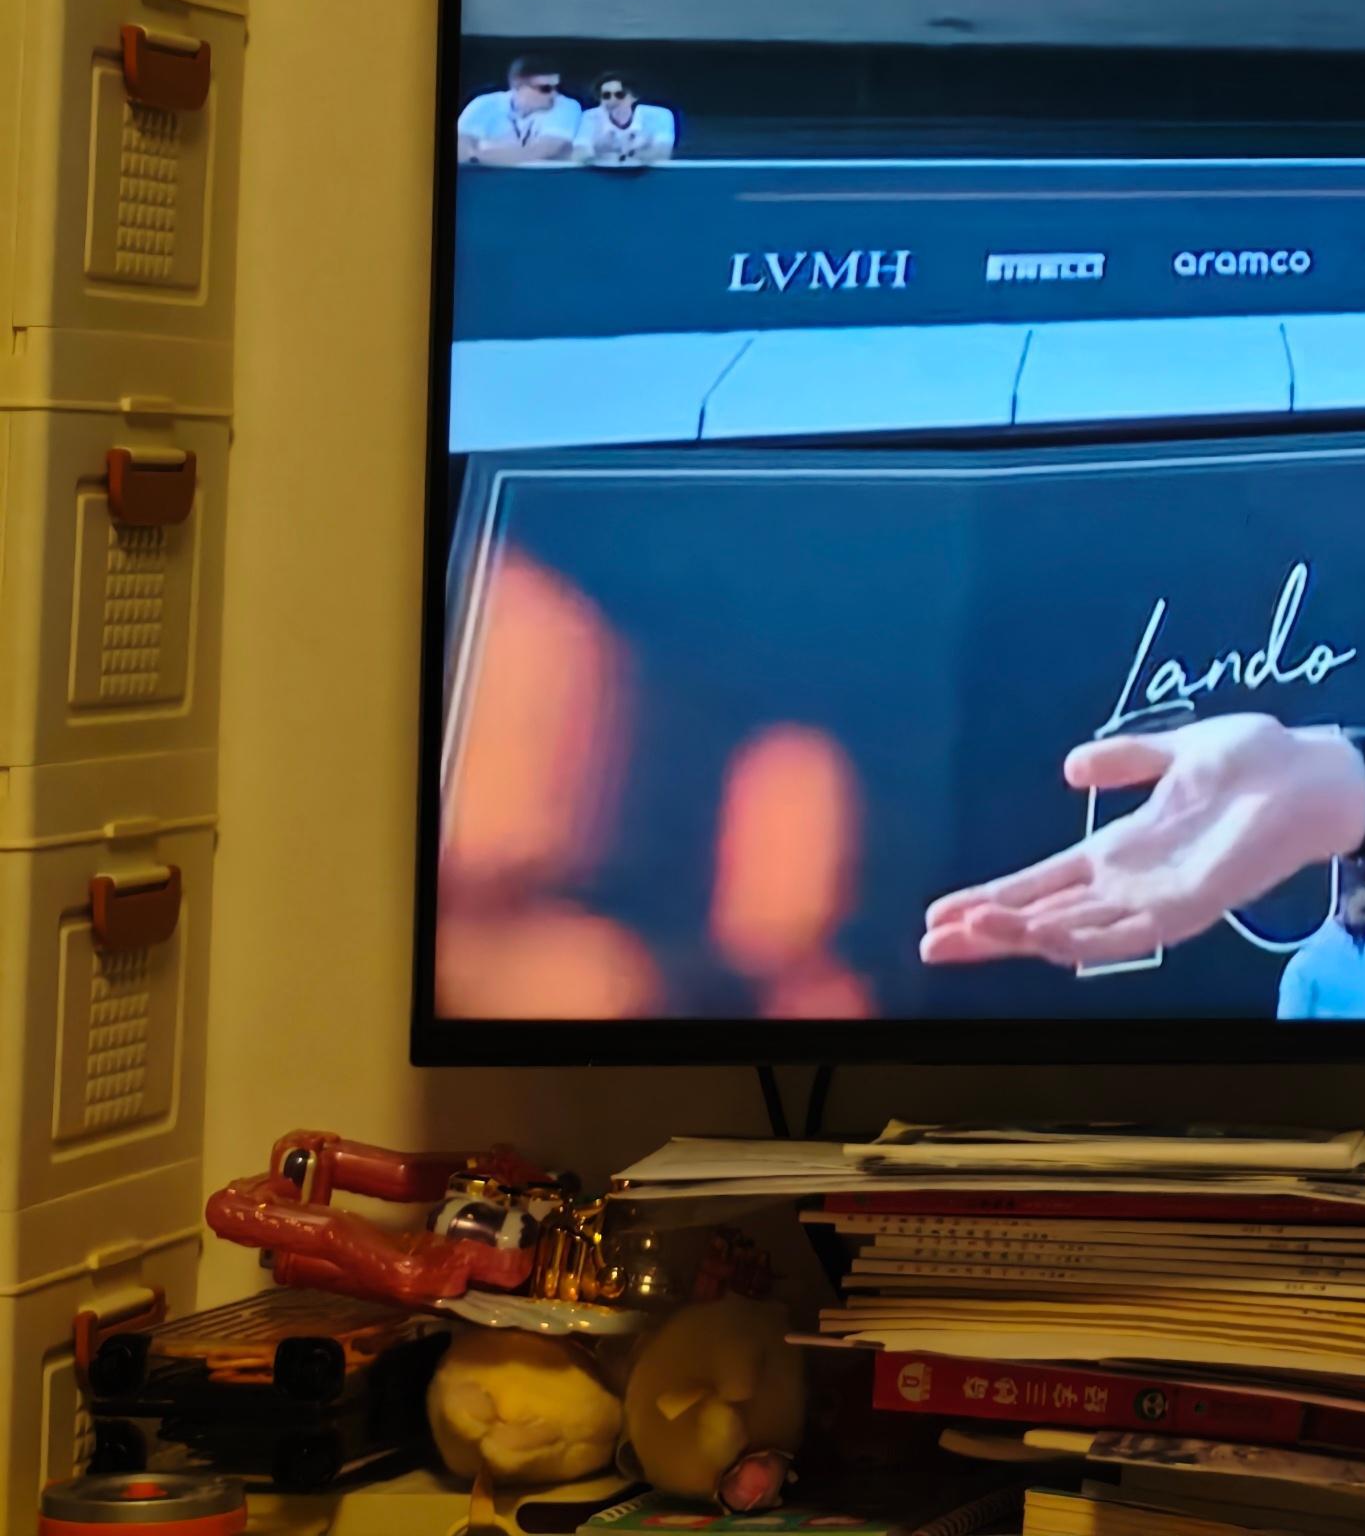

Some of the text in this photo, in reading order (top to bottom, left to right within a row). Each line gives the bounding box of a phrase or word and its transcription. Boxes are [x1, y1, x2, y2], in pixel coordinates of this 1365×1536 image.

[728, 249, 913, 292] LVMH
[1172, 249, 1311, 276] aramco
[1094, 562, 1358, 738] Lando
